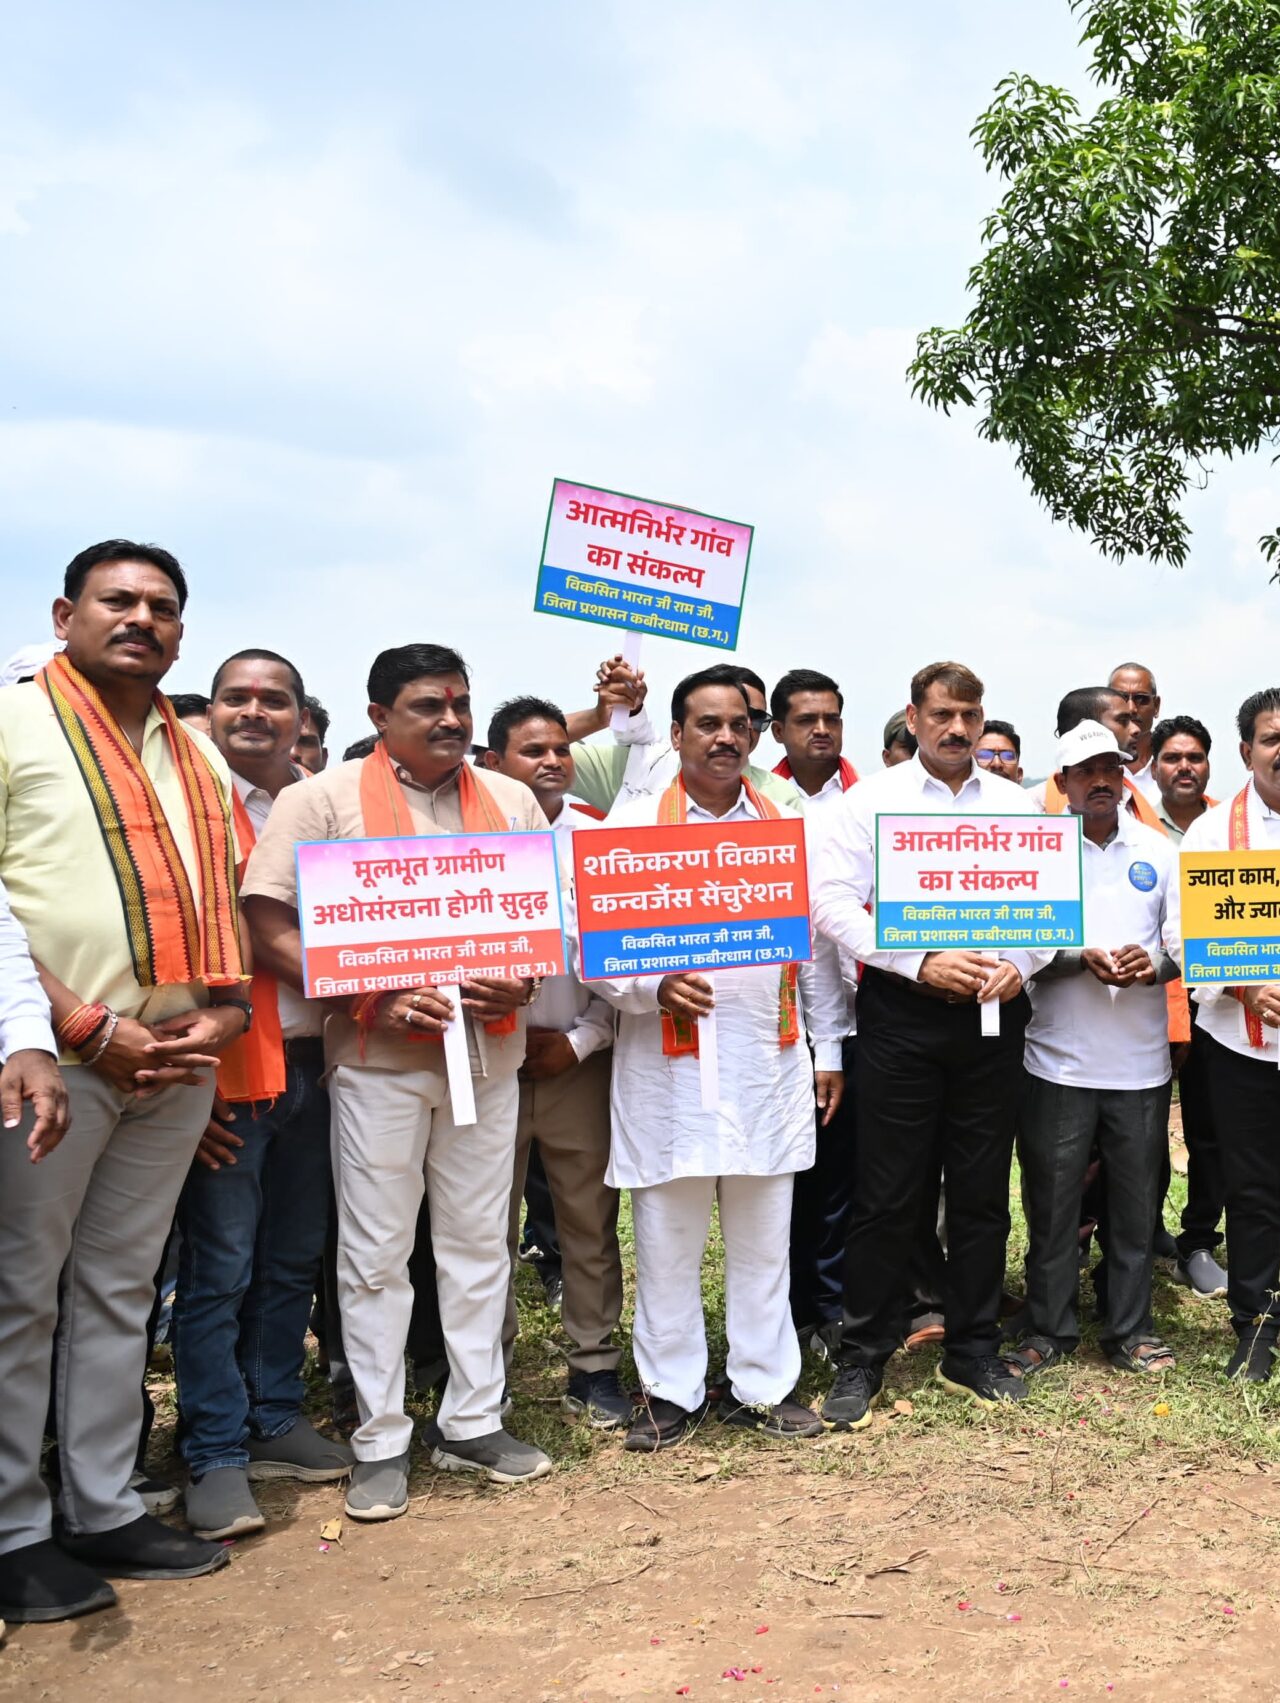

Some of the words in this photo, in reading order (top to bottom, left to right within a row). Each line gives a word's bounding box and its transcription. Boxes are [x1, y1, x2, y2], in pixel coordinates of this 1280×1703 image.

[566, 500, 686, 545] आत्मनिर्भर
[691, 528, 734, 557] गांव
[587, 544, 622, 569] का
[627, 550, 705, 588] संकल्प
[566, 576, 620, 599] विकसित
[623, 590, 653, 606] भारत
[655, 595, 671, 610] जी
[674, 604, 694, 616] राम
[697, 604, 714, 620] जी,
[543, 592, 577, 611] जिला
[580, 603, 627, 622] प्रशासन
[630, 612, 689, 634] कबीरधाम
[691, 625, 729, 644] (छ.ग.)
[892, 824, 1012, 852] आत्मनिर्भर
[1018, 826, 1063, 852] गांव
[353, 857, 428, 888] मूलभूत
[434, 848, 505, 876] ग्रामीण
[583, 848, 710, 876] शक्तिकरण
[715, 841, 796, 868] विकास
[918, 870, 953, 891] का
[958, 864, 1039, 891] संकल्प
[1188, 869, 1234, 887] ज्यादा
[1239, 868, 1280, 887] काम,
[314, 896, 441, 925] अधोसंरचना
[446, 888, 492, 919] होगी
[498, 890, 548, 920] सुदृढ़
[699, 878, 793, 913] सेंचुरेशन
[1214, 896, 1245, 919] और
[903, 906, 957, 921] विकसित
[959, 908, 991, 920] भारत
[994, 905, 1009, 919] जी
[1013, 908, 1033, 919] राम
[1037, 905, 1056, 921] जी,
[622, 933, 676, 950] विकसित
[679, 932, 710, 945] भारत
[713, 929, 729, 943] जी
[732, 931, 752, 941] राम
[755, 925, 774, 941] जी,
[883, 927, 917, 942] जिला
[920, 928, 968, 942] प्रशासन
[972, 926, 1032, 941] कबीरधाम
[1035, 928, 1074, 942] (छ.ग.)
[1207, 941, 1258, 957] विकसित
[338, 947, 409, 968] विकसित
[412, 945, 452, 960] भारत
[457, 940, 475, 958] जी
[480, 941, 505, 955] राम
[510, 936, 534, 954] जी,
[604, 957, 638, 973] जिला
[641, 954, 689, 969] प्रशासन
[692, 948, 752, 965] कबीरधाम
[755, 946, 793, 962] (छ.ग.)
[314, 978, 358, 996] जिला
[364, 972, 425, 991] प्रशासन
[510, 961, 557, 980] (छ.ग.)
[1190, 963, 1220, 978] जिला
[1223, 963, 1269, 977] प्रशासन
